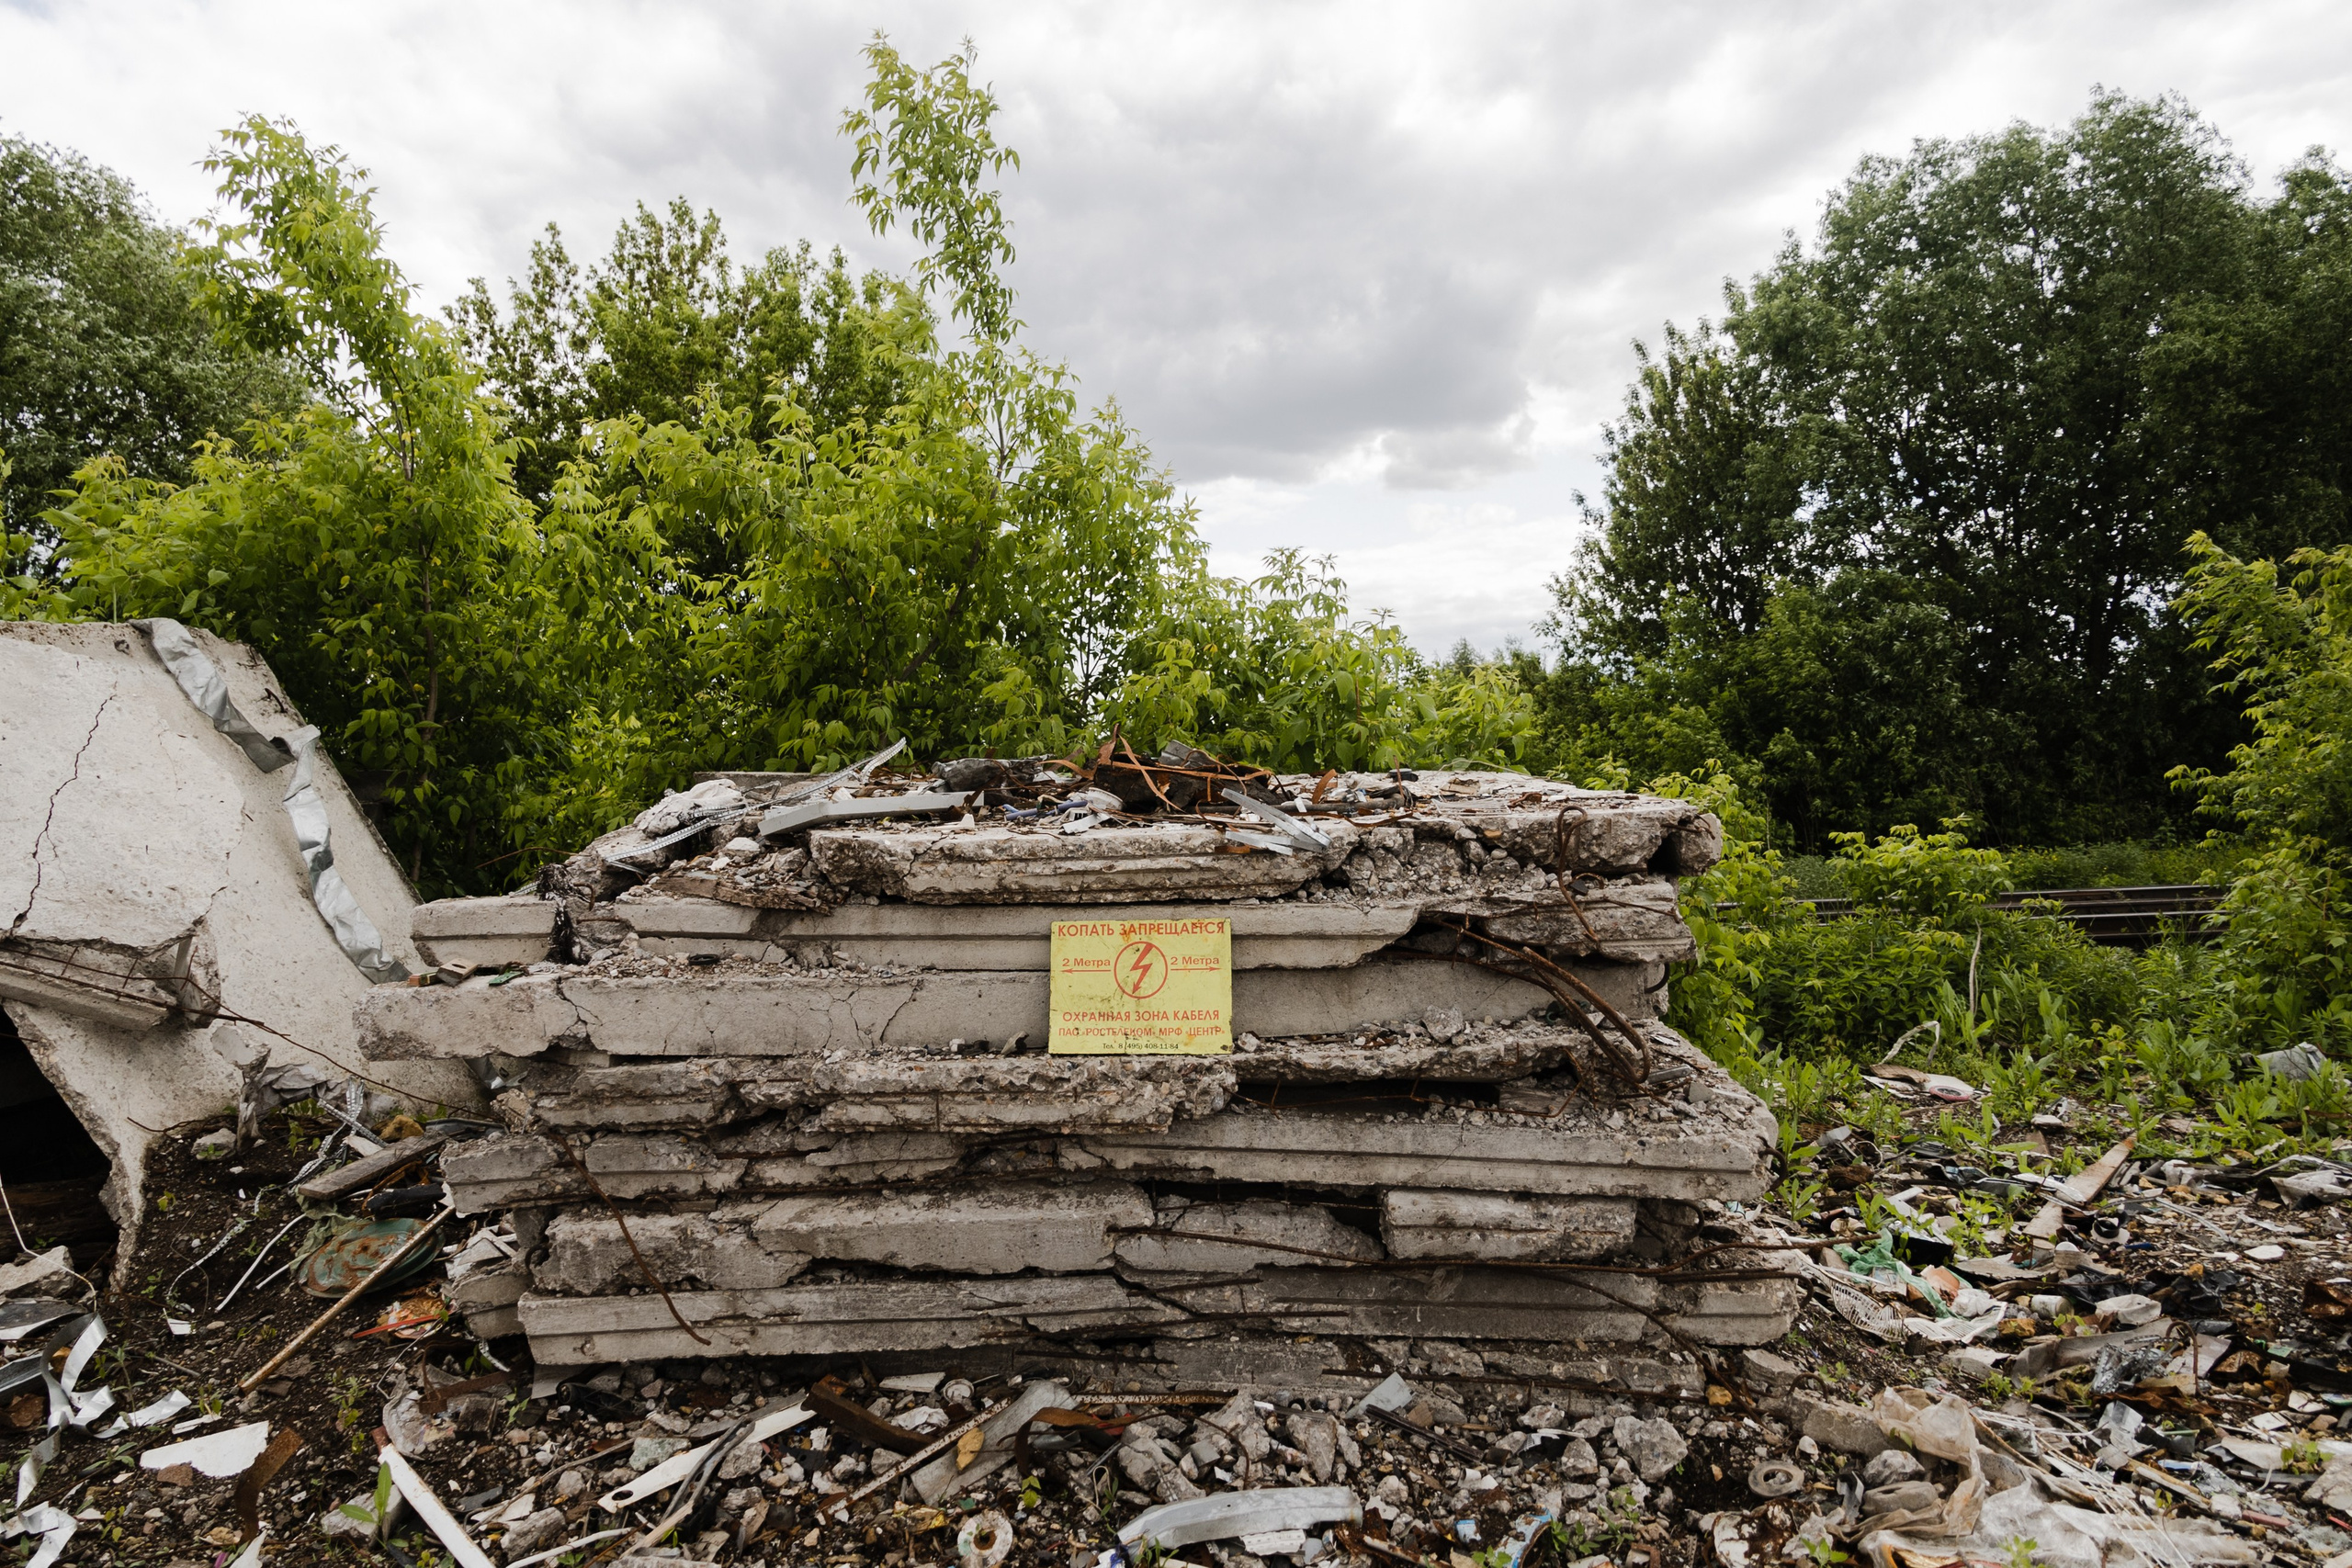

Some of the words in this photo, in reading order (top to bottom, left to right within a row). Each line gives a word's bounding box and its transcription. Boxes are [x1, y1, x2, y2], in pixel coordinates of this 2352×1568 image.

[1057, 924, 1114, 936] КОПАТЬ
[1119, 921, 1225, 936] ЗАПРЕЩАЕТСЯ
[1062, 958, 1070, 966] 2
[1073, 958, 1111, 968] Метра
[1170, 957, 1179, 965] 2
[1182, 956, 1219, 965] Метра
[1062, 1011, 1131, 1022] ОХРАННАЯ
[1135, 1010, 1170, 1021] ЗОНА
[1173, 1010, 1219, 1021] КАБЕЛЯ
[1159, 1027, 1182, 1036] МРФ
